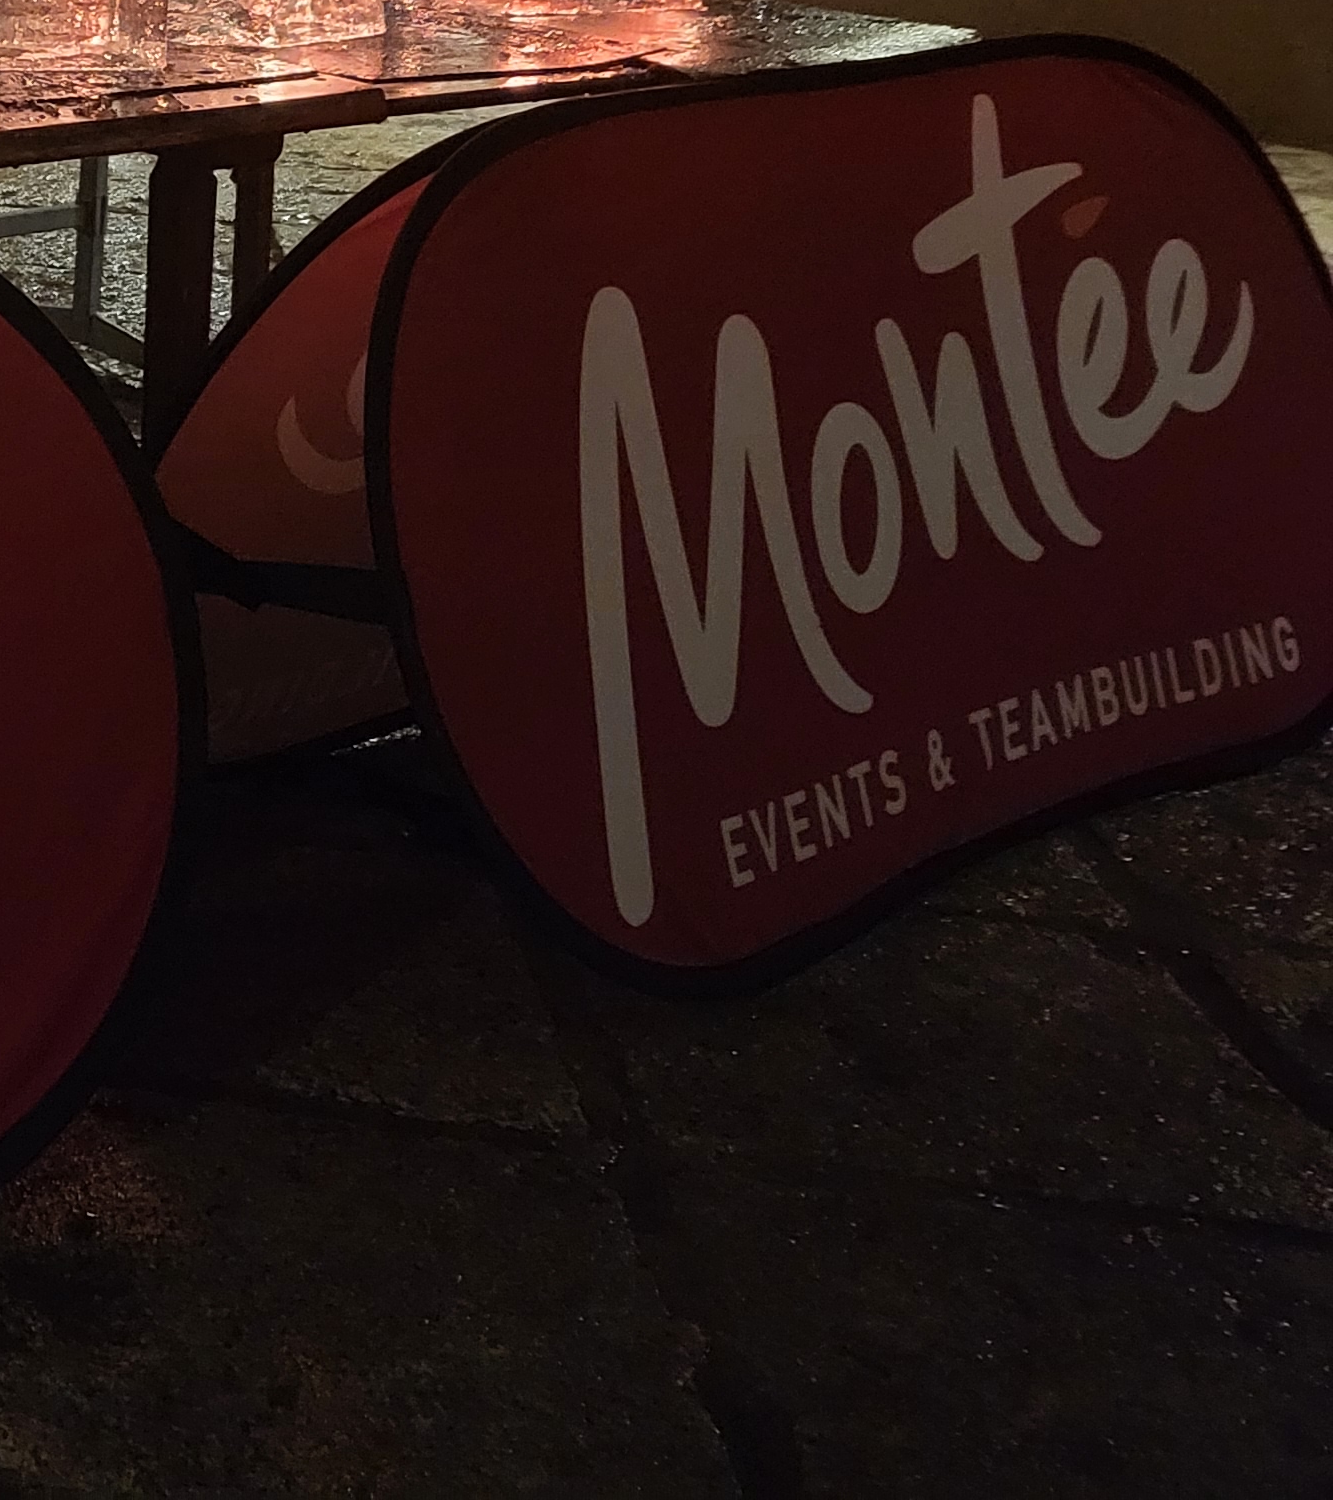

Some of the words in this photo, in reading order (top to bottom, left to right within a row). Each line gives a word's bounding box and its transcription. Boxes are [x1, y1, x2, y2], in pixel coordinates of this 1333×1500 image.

[577, 92, 1255, 928] Montée
[718, 748, 909, 889] EVENTS
[927, 727, 956, 793] &
[967, 614, 1302, 771] TEAMBUILDING
